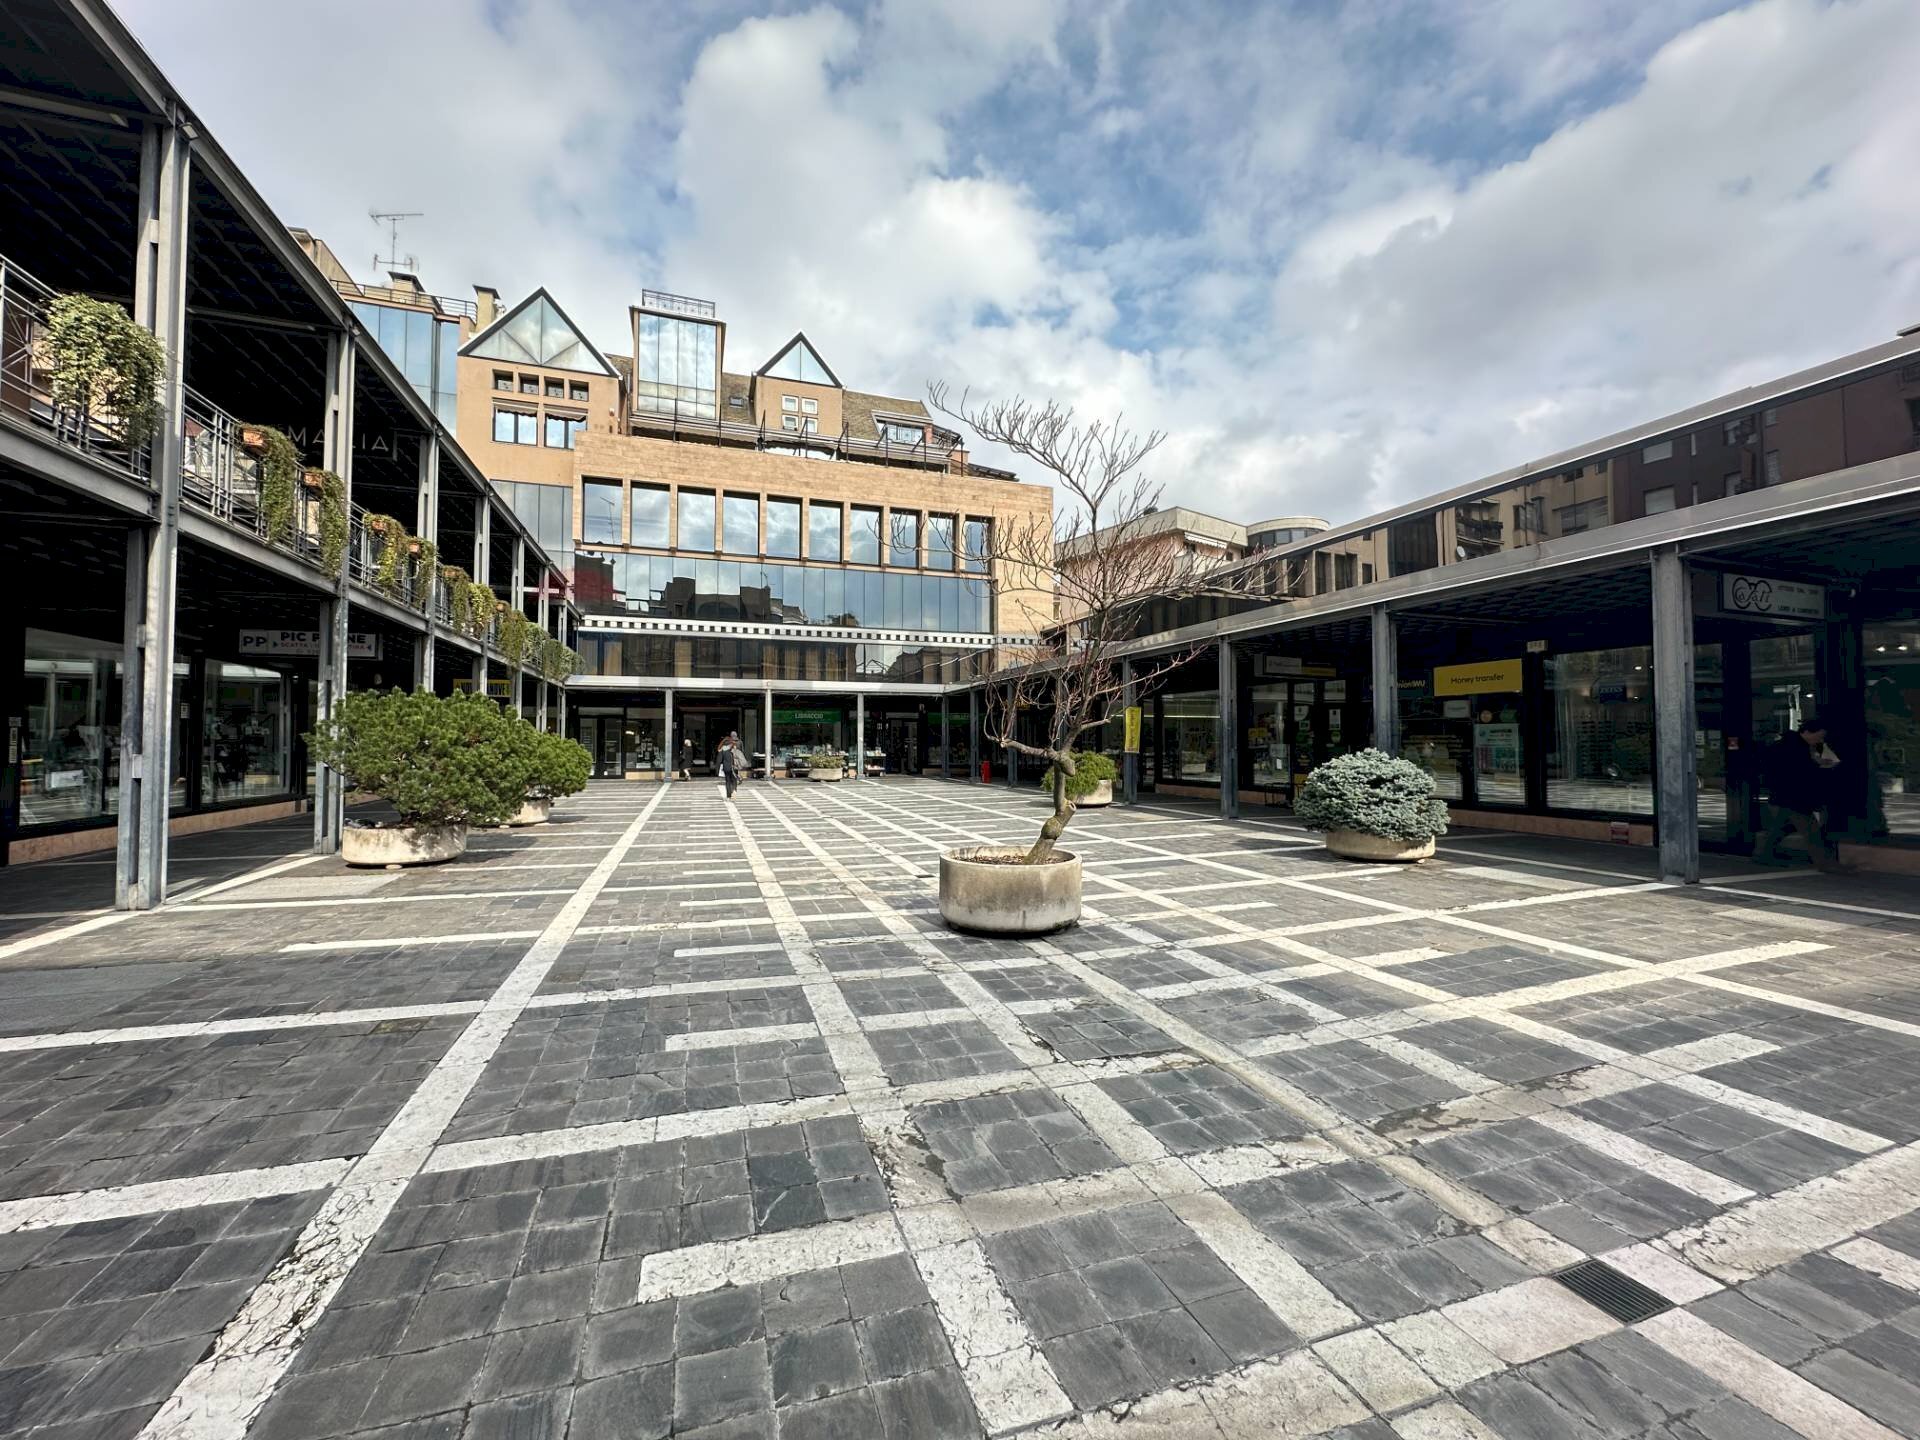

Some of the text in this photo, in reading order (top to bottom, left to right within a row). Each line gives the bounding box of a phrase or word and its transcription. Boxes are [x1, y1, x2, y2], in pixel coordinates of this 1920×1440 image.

[243, 635, 268, 647] PP
[281, 632, 367, 644] PIC PNE
[1450, 673, 1505, 685] Money transfer
